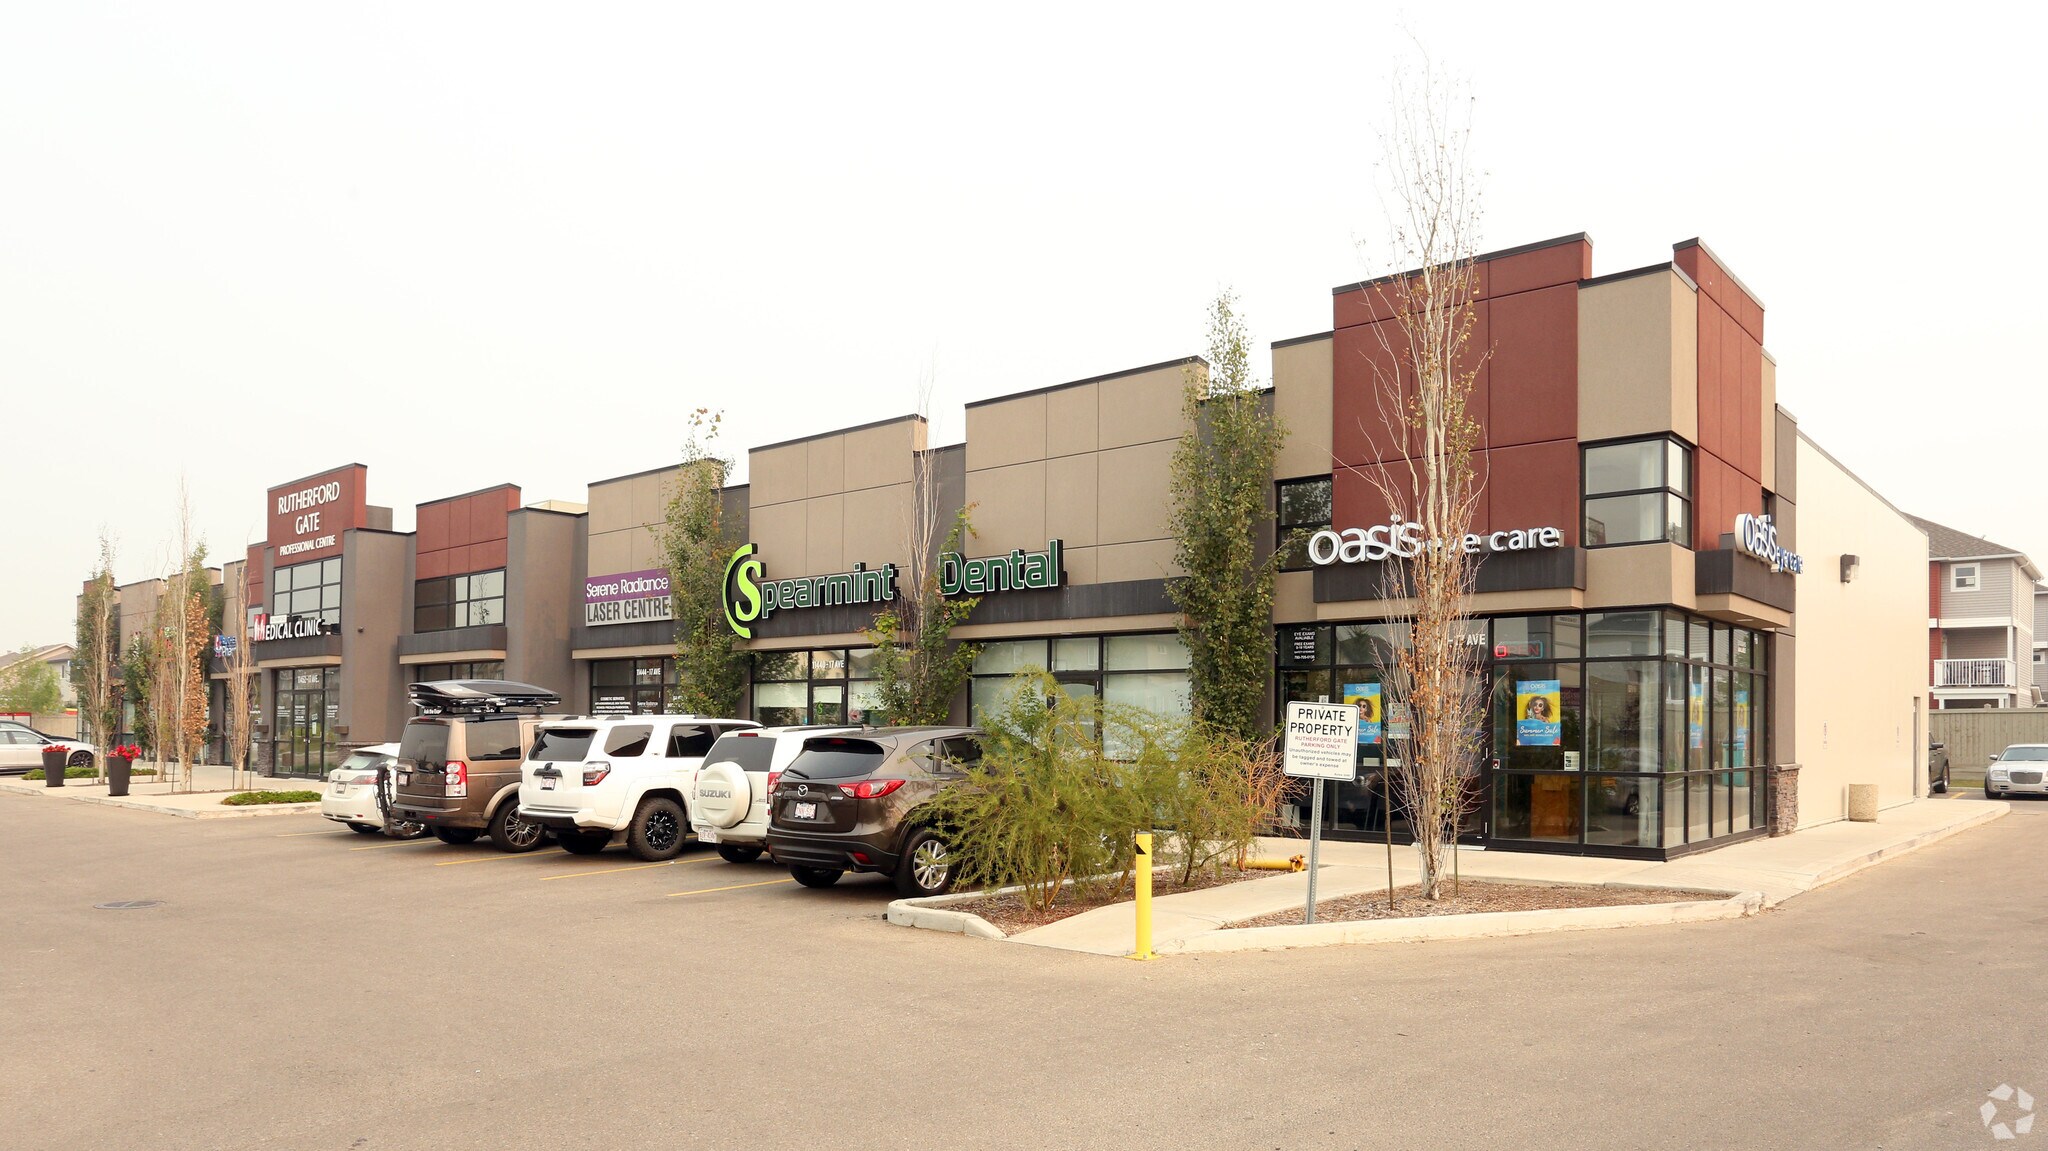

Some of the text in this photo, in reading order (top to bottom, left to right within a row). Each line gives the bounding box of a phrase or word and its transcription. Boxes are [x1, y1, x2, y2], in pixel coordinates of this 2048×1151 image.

[278, 481, 340, 515] RUTHERFORD
[295, 511, 320, 535] GATE
[279, 534, 336, 556] PROFESSIONAL CENTRE
[1489, 526, 1562, 552] care
[586, 577, 669, 598] Serene Radiance
[734, 539, 1060, 621] Spearmint Dental
[587, 596, 669, 623] LASER CENTRE
[254, 613, 292, 641] MEDICAL
[294, 618, 322, 638] CLINIC
[1466, 633, 1486, 645] AVE
[1298, 708, 1346, 722] PRIVATE
[1290, 722, 1353, 737] PROPERTY
[1295, 735, 1332, 743] RUTHERFORD
[699, 789, 731, 799] SUZUKI
